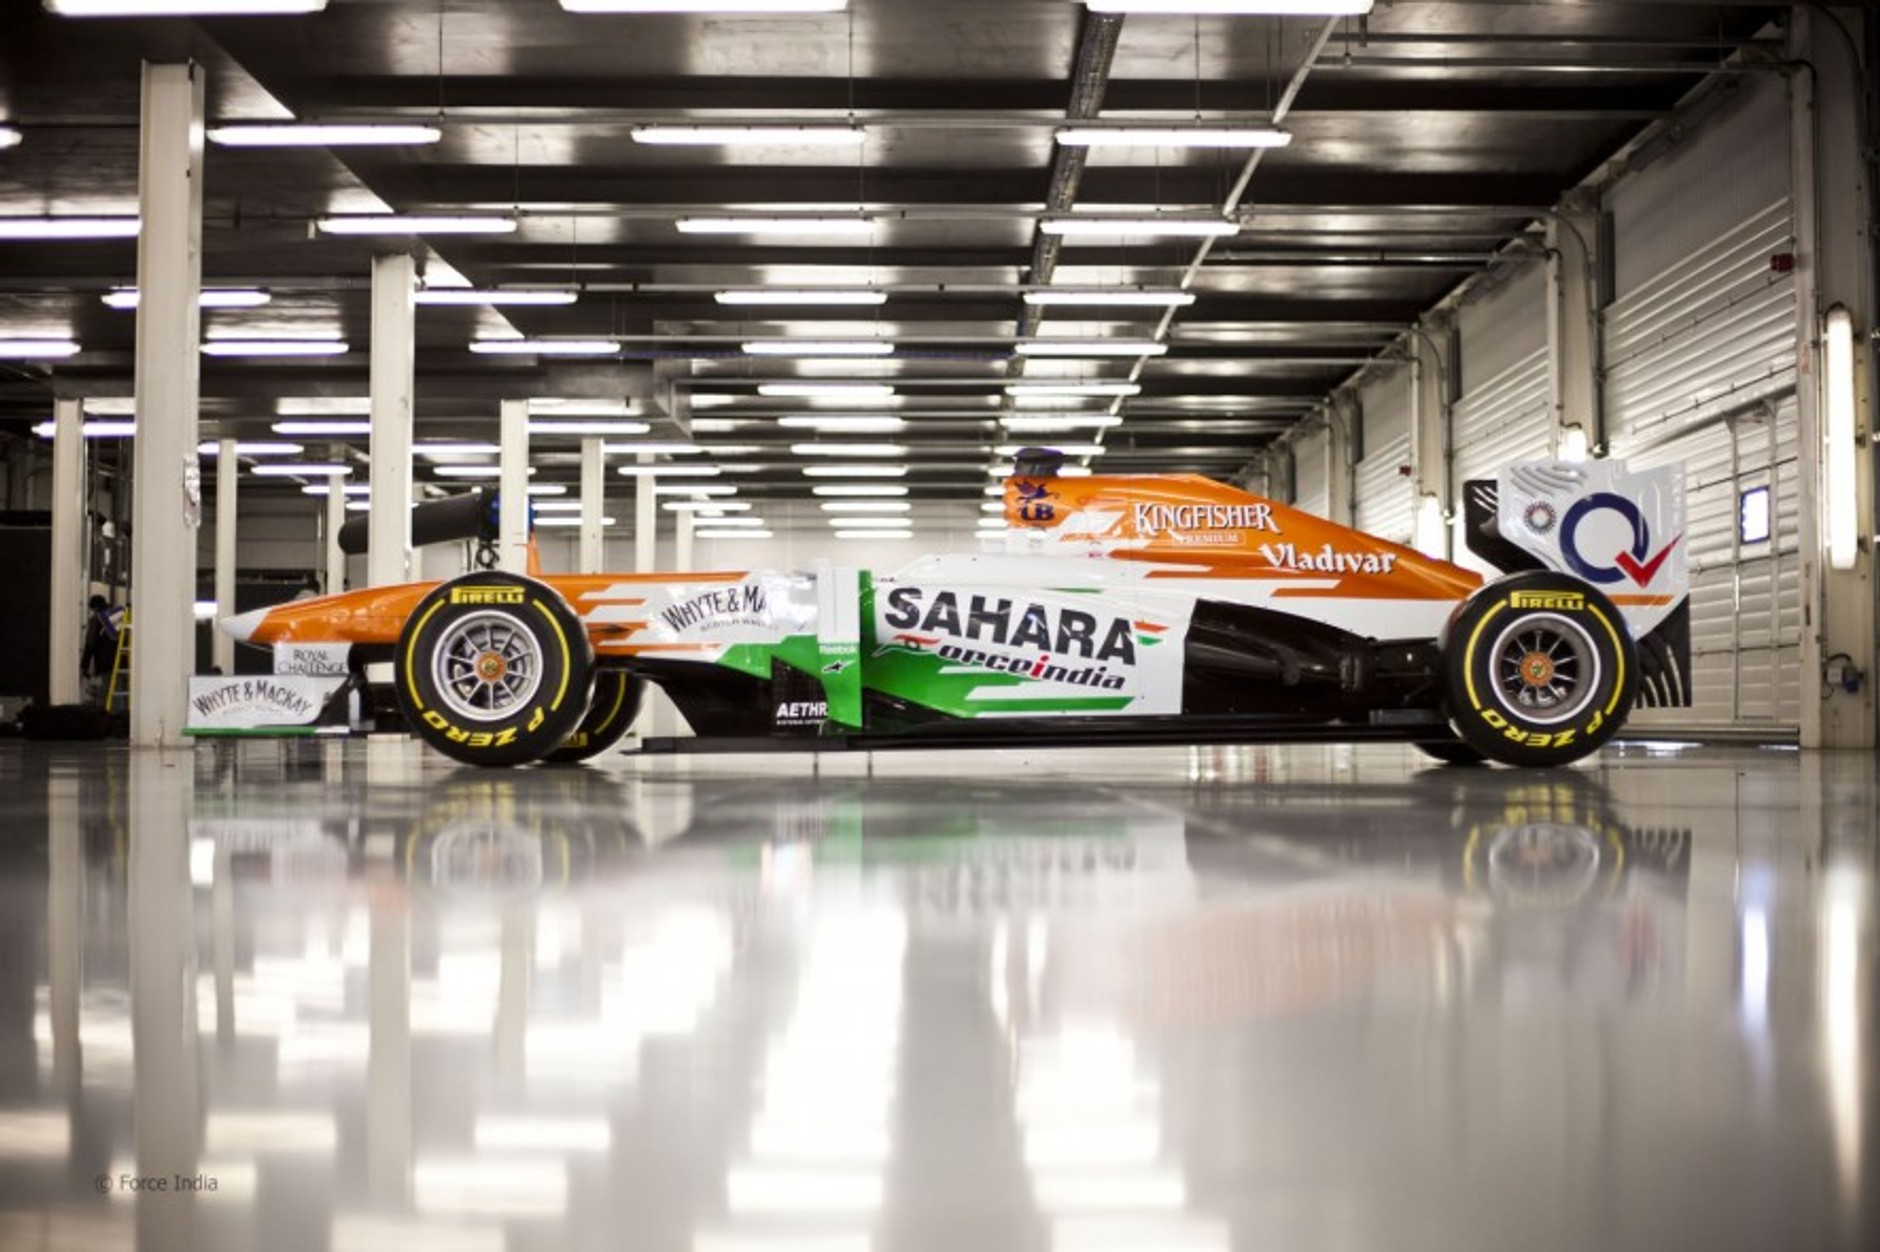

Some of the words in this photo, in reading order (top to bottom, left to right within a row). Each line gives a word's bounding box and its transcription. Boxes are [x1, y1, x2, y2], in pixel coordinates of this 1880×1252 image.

[1134, 502, 1282, 541] KINGFISHER
[1258, 543, 1397, 574] Vladivar
[451, 585, 525, 604] PIRELLI
[661, 591, 726, 633] WHYTE
[727, 587, 740, 612] &
[1510, 590, 1584, 610] PIRELLI
[884, 587, 1136, 666] SAHARA
[278, 660, 347, 675] CHALLENGE
[293, 649, 329, 661] ROYAL
[192, 682, 240, 717] WHYTE
[244, 681, 254, 702] &
[255, 679, 313, 716] MACKAY
[422, 709, 518, 747] ZERO
[527, 706, 545, 733] P
[1481, 709, 1576, 749] ZERO
[1586, 709, 1603, 735] P
